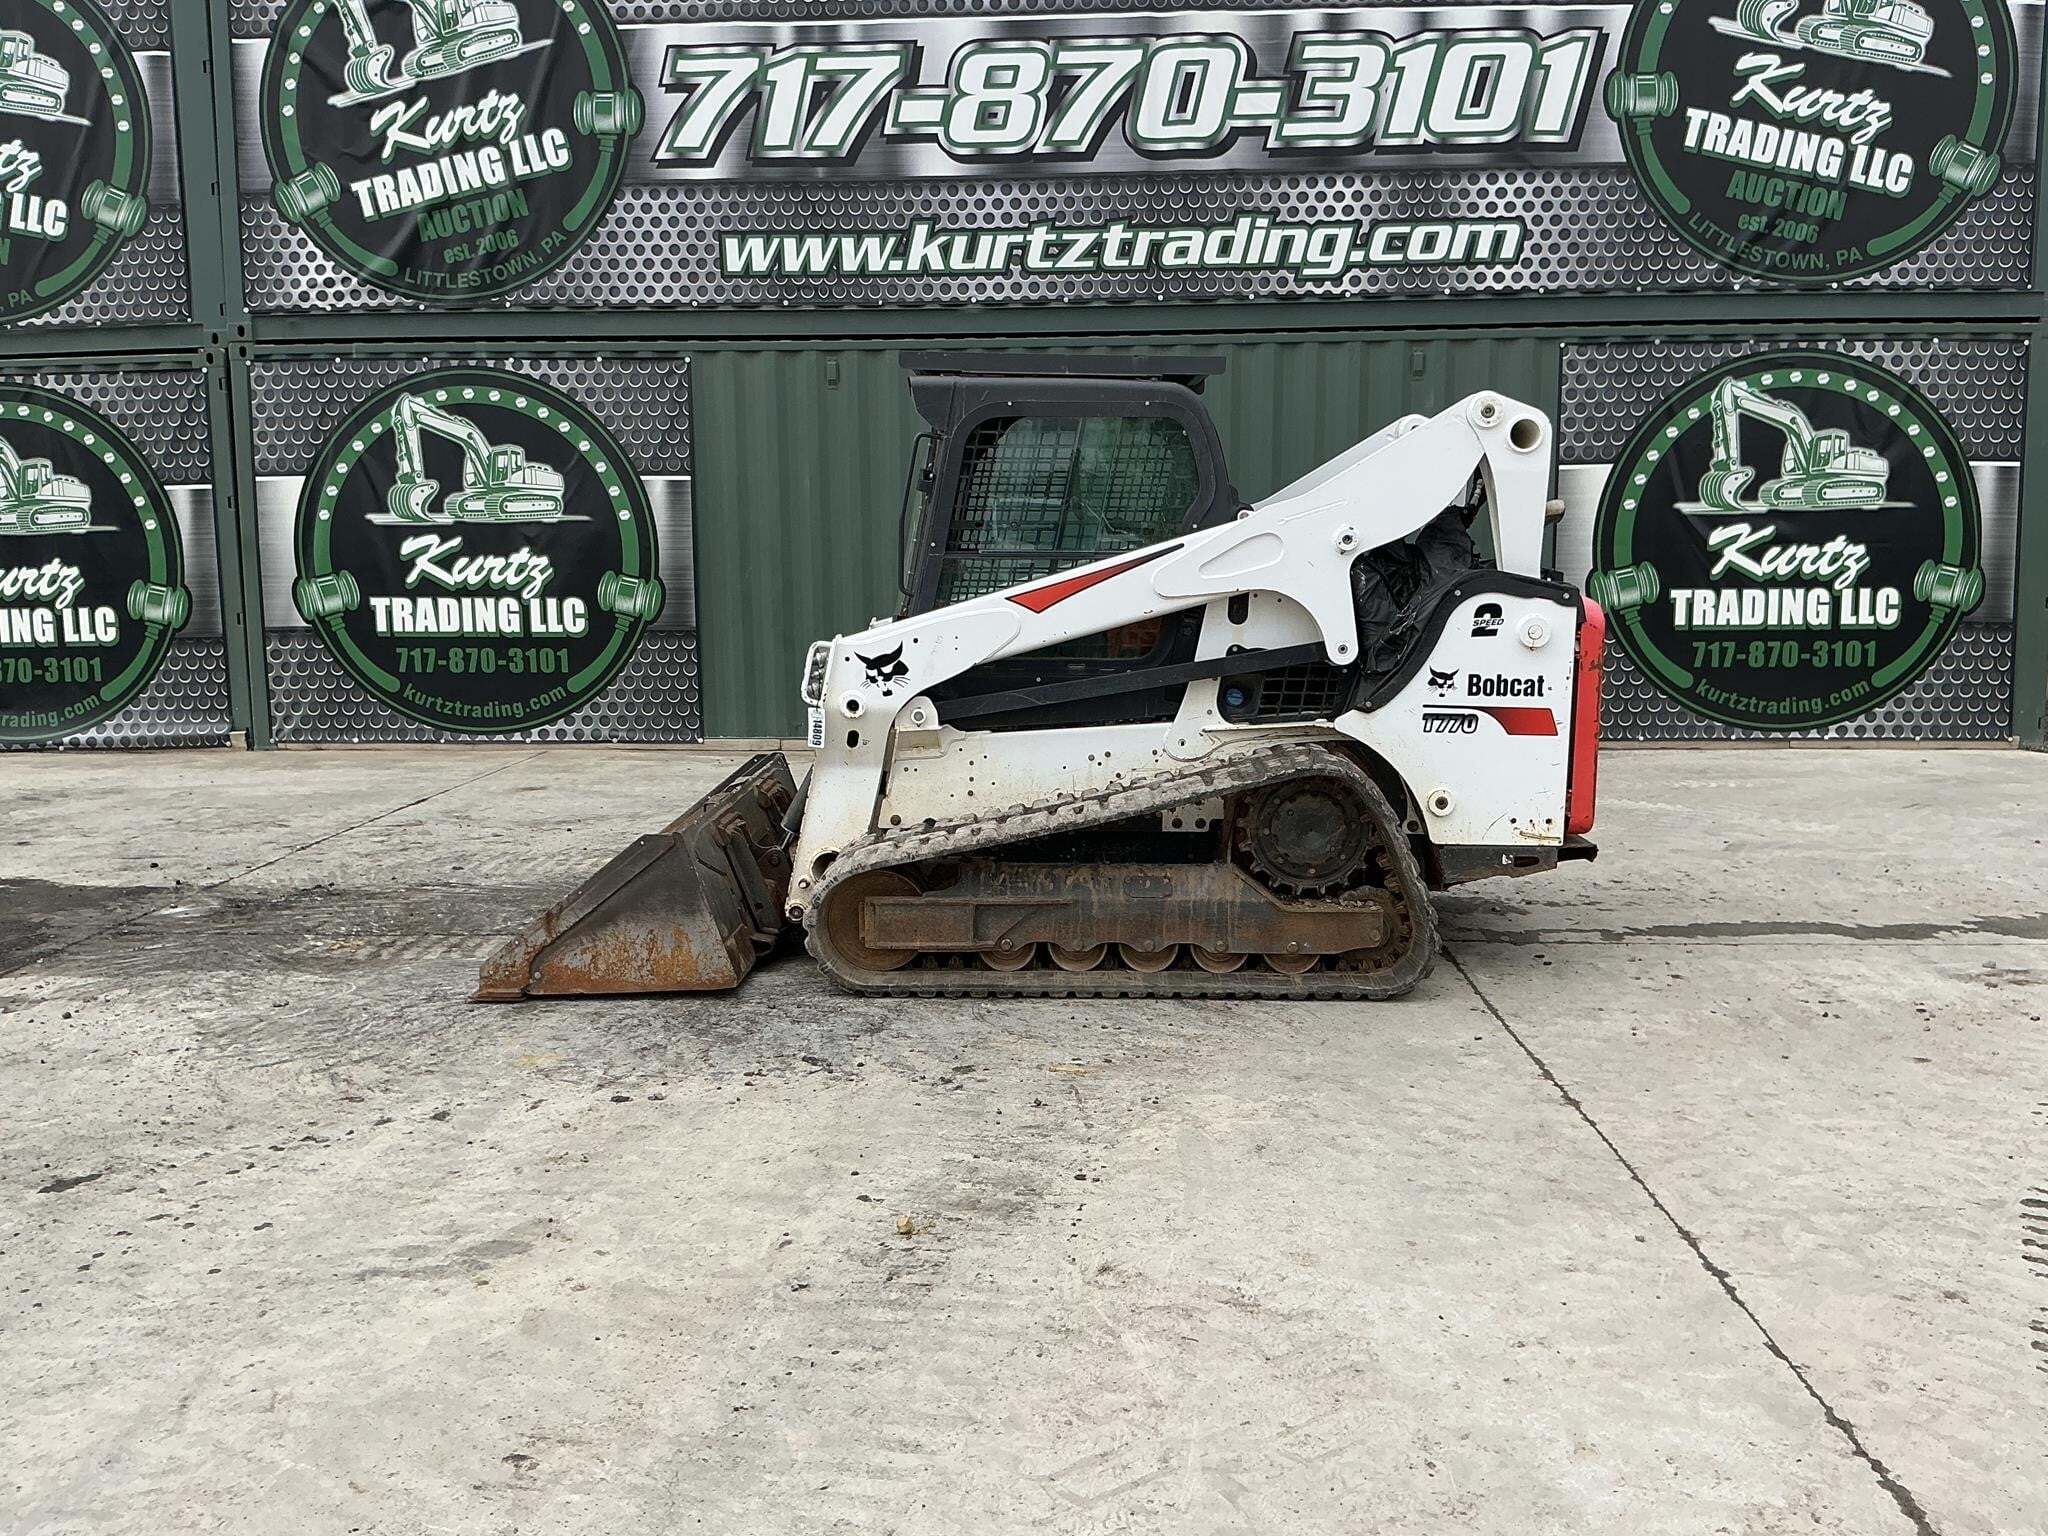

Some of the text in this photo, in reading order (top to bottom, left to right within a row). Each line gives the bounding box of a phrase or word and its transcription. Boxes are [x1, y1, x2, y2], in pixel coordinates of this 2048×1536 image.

[656, 30, 1600, 160] 717-870-3101
[1729, 52, 1893, 145] Kurtz
[370, 89, 526, 162] Kurtz
[1684, 107, 1914, 196] TRADING LLC
[350, 128, 572, 221] TRADING LLC
[416, 188, 530, 243] AUCTION
[1726, 170, 1848, 221] AUCTION
[10, 192, 69, 240] LLC
[1737, 213, 1820, 244] est. 2006
[404, 230, 567, 288] LITTLESTOWN, PA
[475, 229, 520, 257] 2006
[721, 214, 1525, 279] www.kurtztrading.com
[1688, 212, 1864, 270] LITTLESTOWN, PA
[7, 290, 33, 307] PA
[400, 533, 554, 600] Kurtz
[1707, 523, 1870, 590] Kurtz
[0, 557, 85, 611] urtz
[62, 606, 118, 646] LLC
[369, 597, 588, 637] TRADING LLC
[1471, 602, 1503, 638] 2
[1472, 618, 1505, 627] SPEED
[1670, 587, 1901, 630] TRADING LLC
[0, 656, 102, 683] 70-3101
[396, 647, 569, 674] 717-870-3101
[1692, 640, 1877, 668] 717-870-3101
[402, 683, 567, 718] kurtztrading.com
[1467, 673, 1545, 697] Bobcat
[1695, 678, 1870, 715] kurtztrading.com
[0, 694, 100, 727] rading.com
[1422, 713, 1479, 734] T770
[812, 720, 823, 746] 14809
